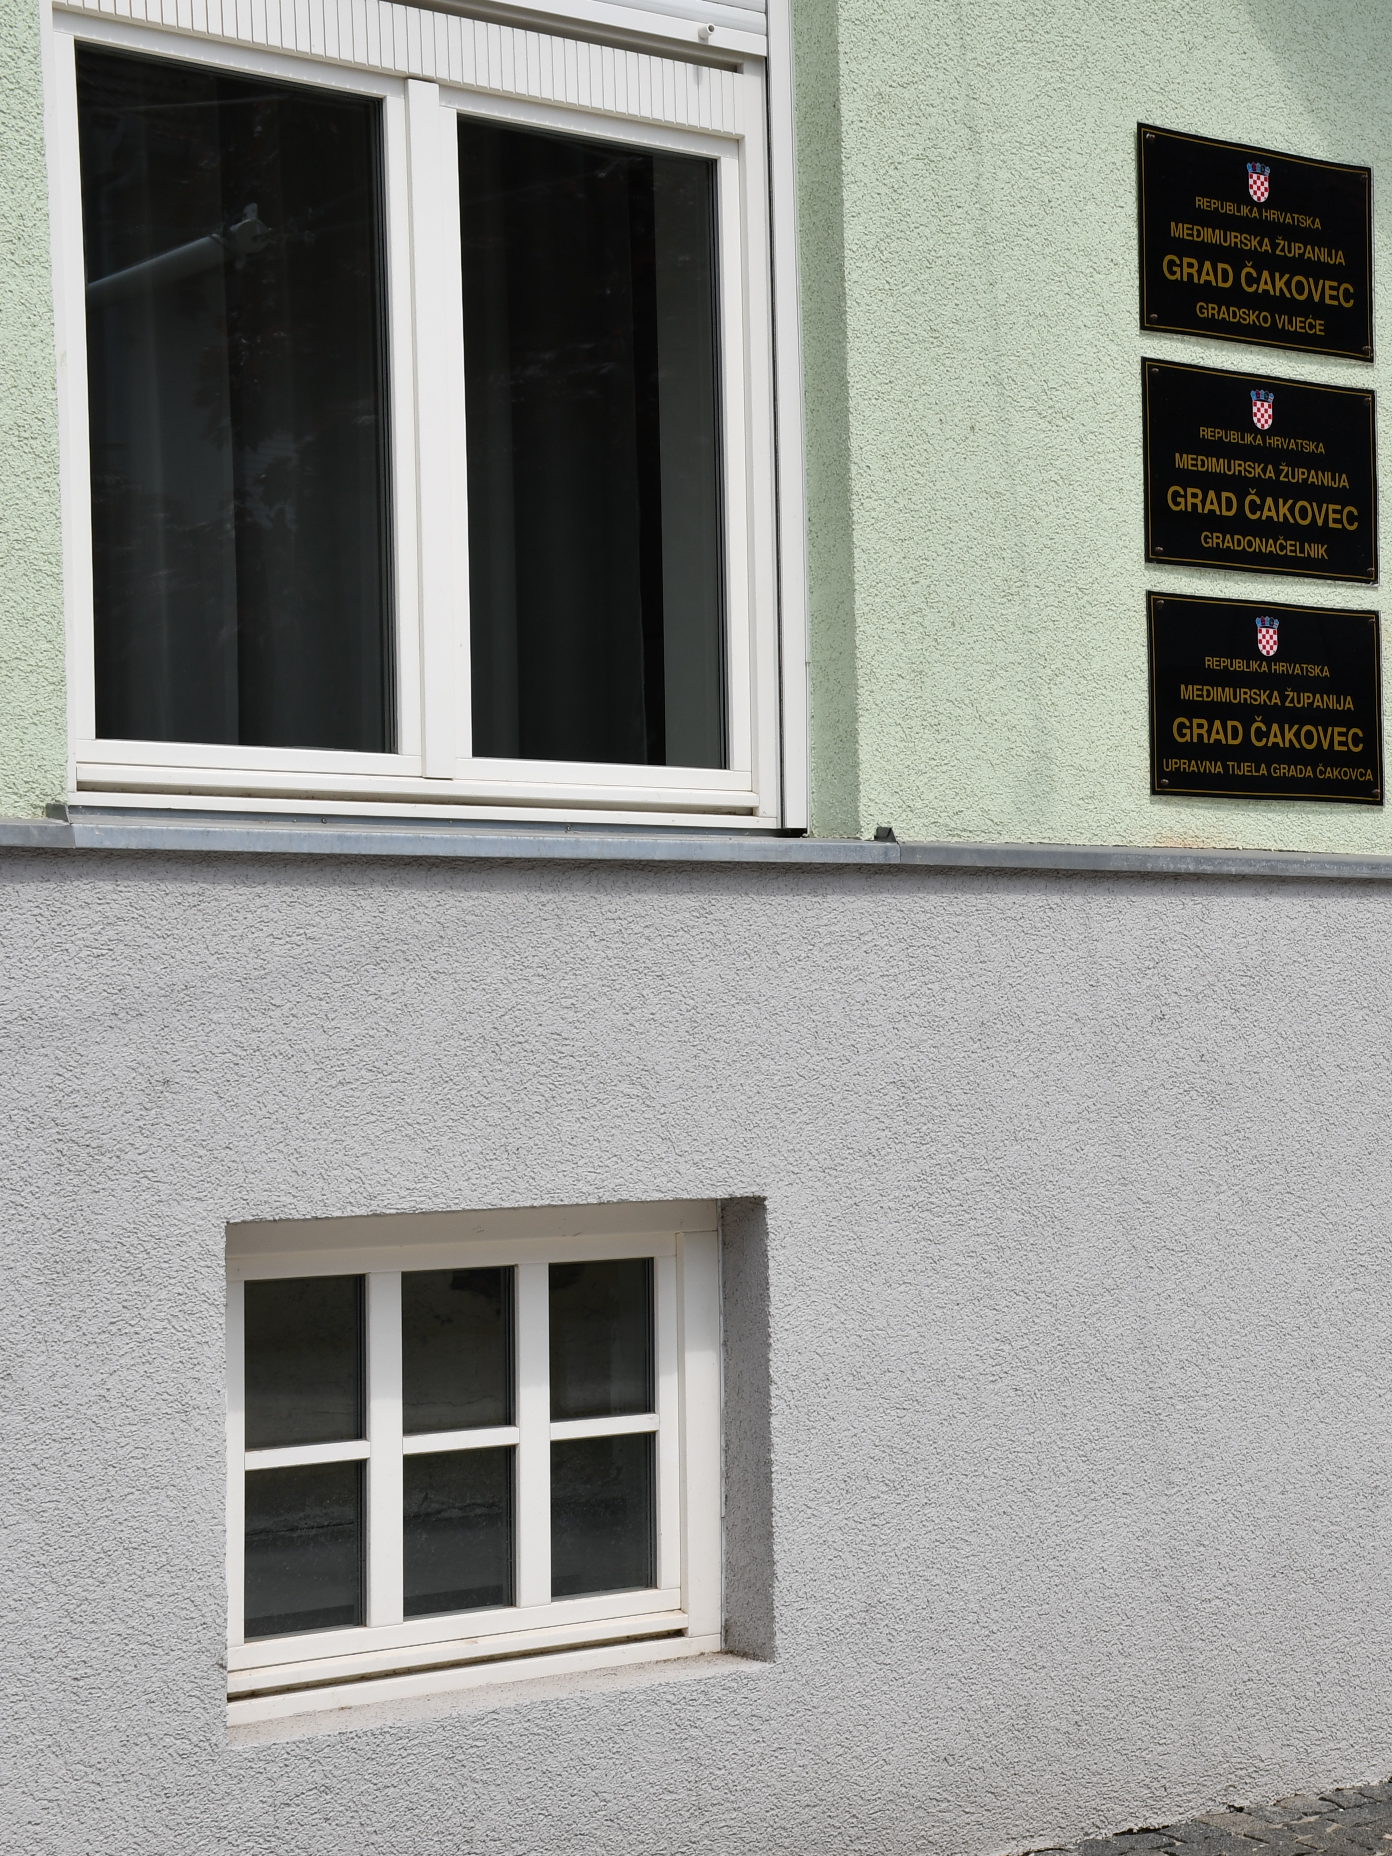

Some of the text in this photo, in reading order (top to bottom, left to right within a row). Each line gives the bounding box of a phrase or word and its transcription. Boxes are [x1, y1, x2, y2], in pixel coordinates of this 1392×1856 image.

[1195, 196, 1321, 231] REPUBLIKA HRVATSKA
[1170, 221, 1346, 266] MEĐIMURSKA ŽUPANIJA
[1162, 254, 1355, 308] GRAD ČAKOVEC
[1196, 302, 1325, 336] GRADSKO VIJEĆE
[1200, 426, 1325, 455] REPUBLIKA HRVATSKA
[1175, 452, 1350, 489] MEĐIMURSKA ŽUPANIJA
[1167, 485, 1359, 531] GRAD ČAKOVEC
[1200, 531, 1328, 560] GRADONAČELNIK
[1205, 656, 1330, 678] REPUBLIKA HRVATSKA
[1180, 684, 1354, 711] MEĐIMURSKA ŽUPANIJA
[1172, 716, 1364, 752] GRAD ČAKOVEC
[1163, 758, 1374, 781] UPRAVNA TIJELA GRADA ČAKOVCA
